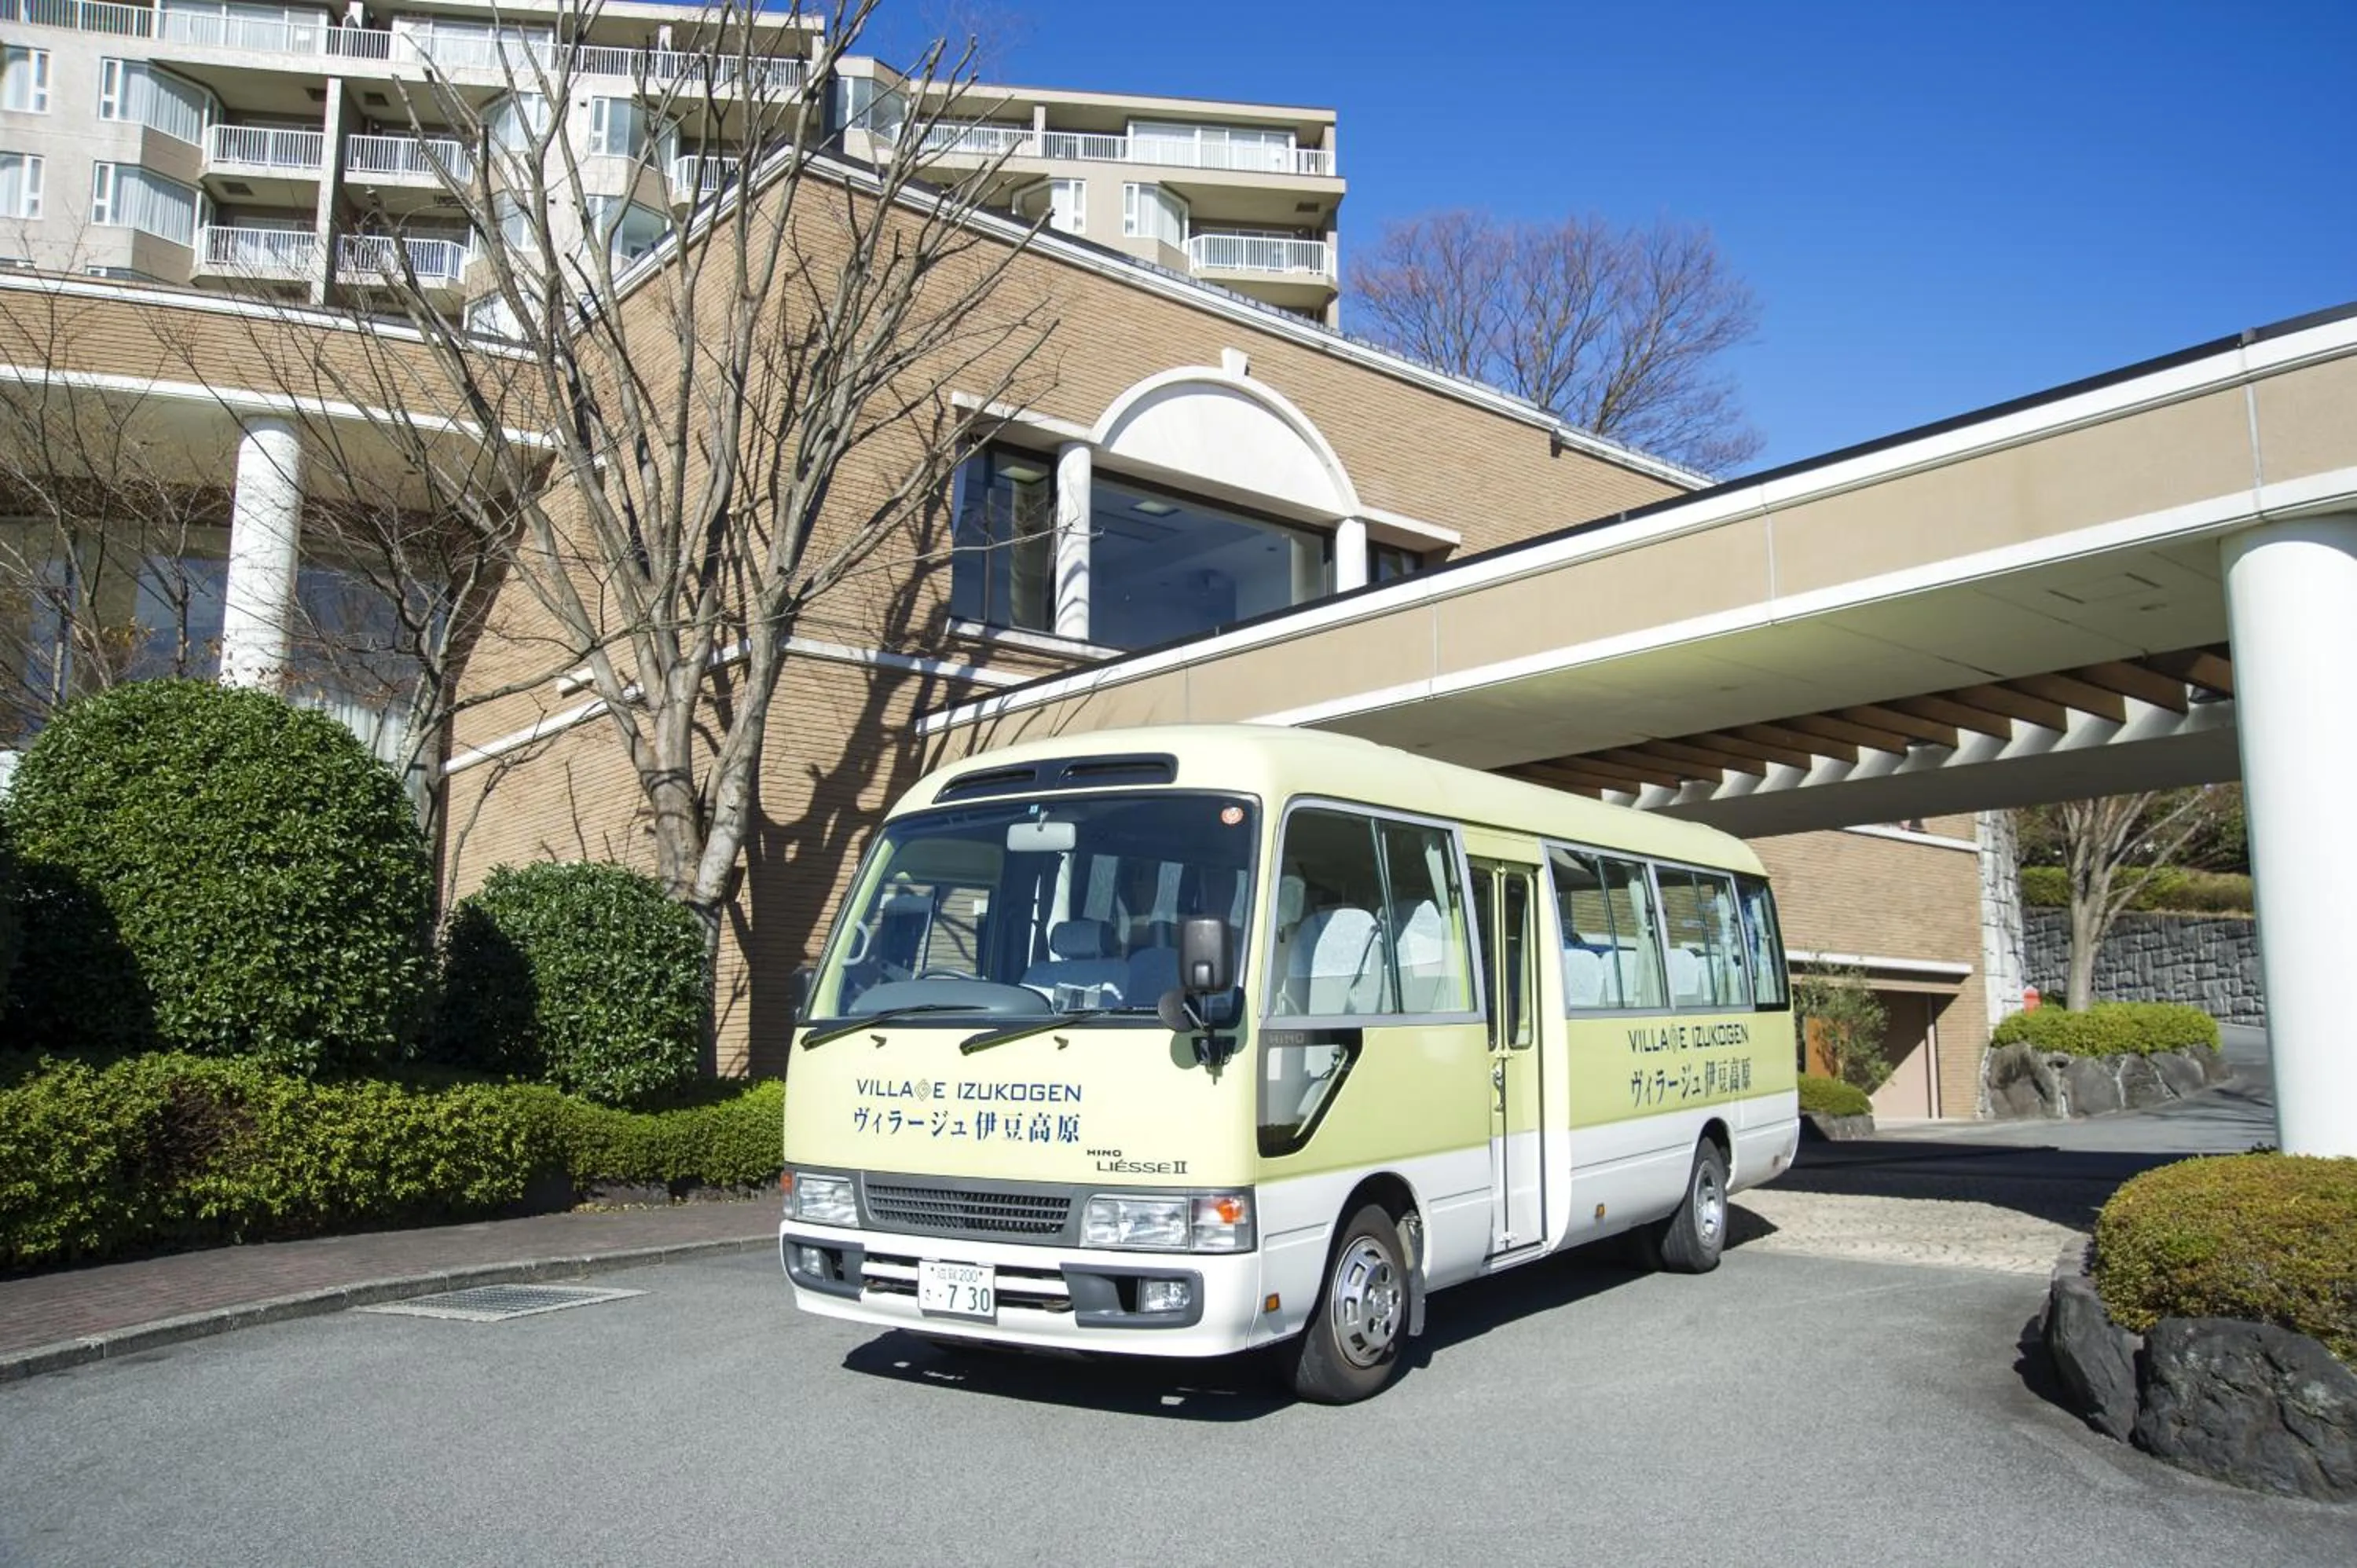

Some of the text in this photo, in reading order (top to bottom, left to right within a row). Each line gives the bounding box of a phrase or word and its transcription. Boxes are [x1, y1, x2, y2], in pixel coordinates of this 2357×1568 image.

[1692, 1021, 1749, 1047] IZUKOGEN
[958, 1083, 1081, 1102] IZUKOGEN
[1631, 1057, 1751, 1108] ヴィラージュ伊豆高原
[854, 1107, 1080, 1142] ヴィラージュ伊豆高原
